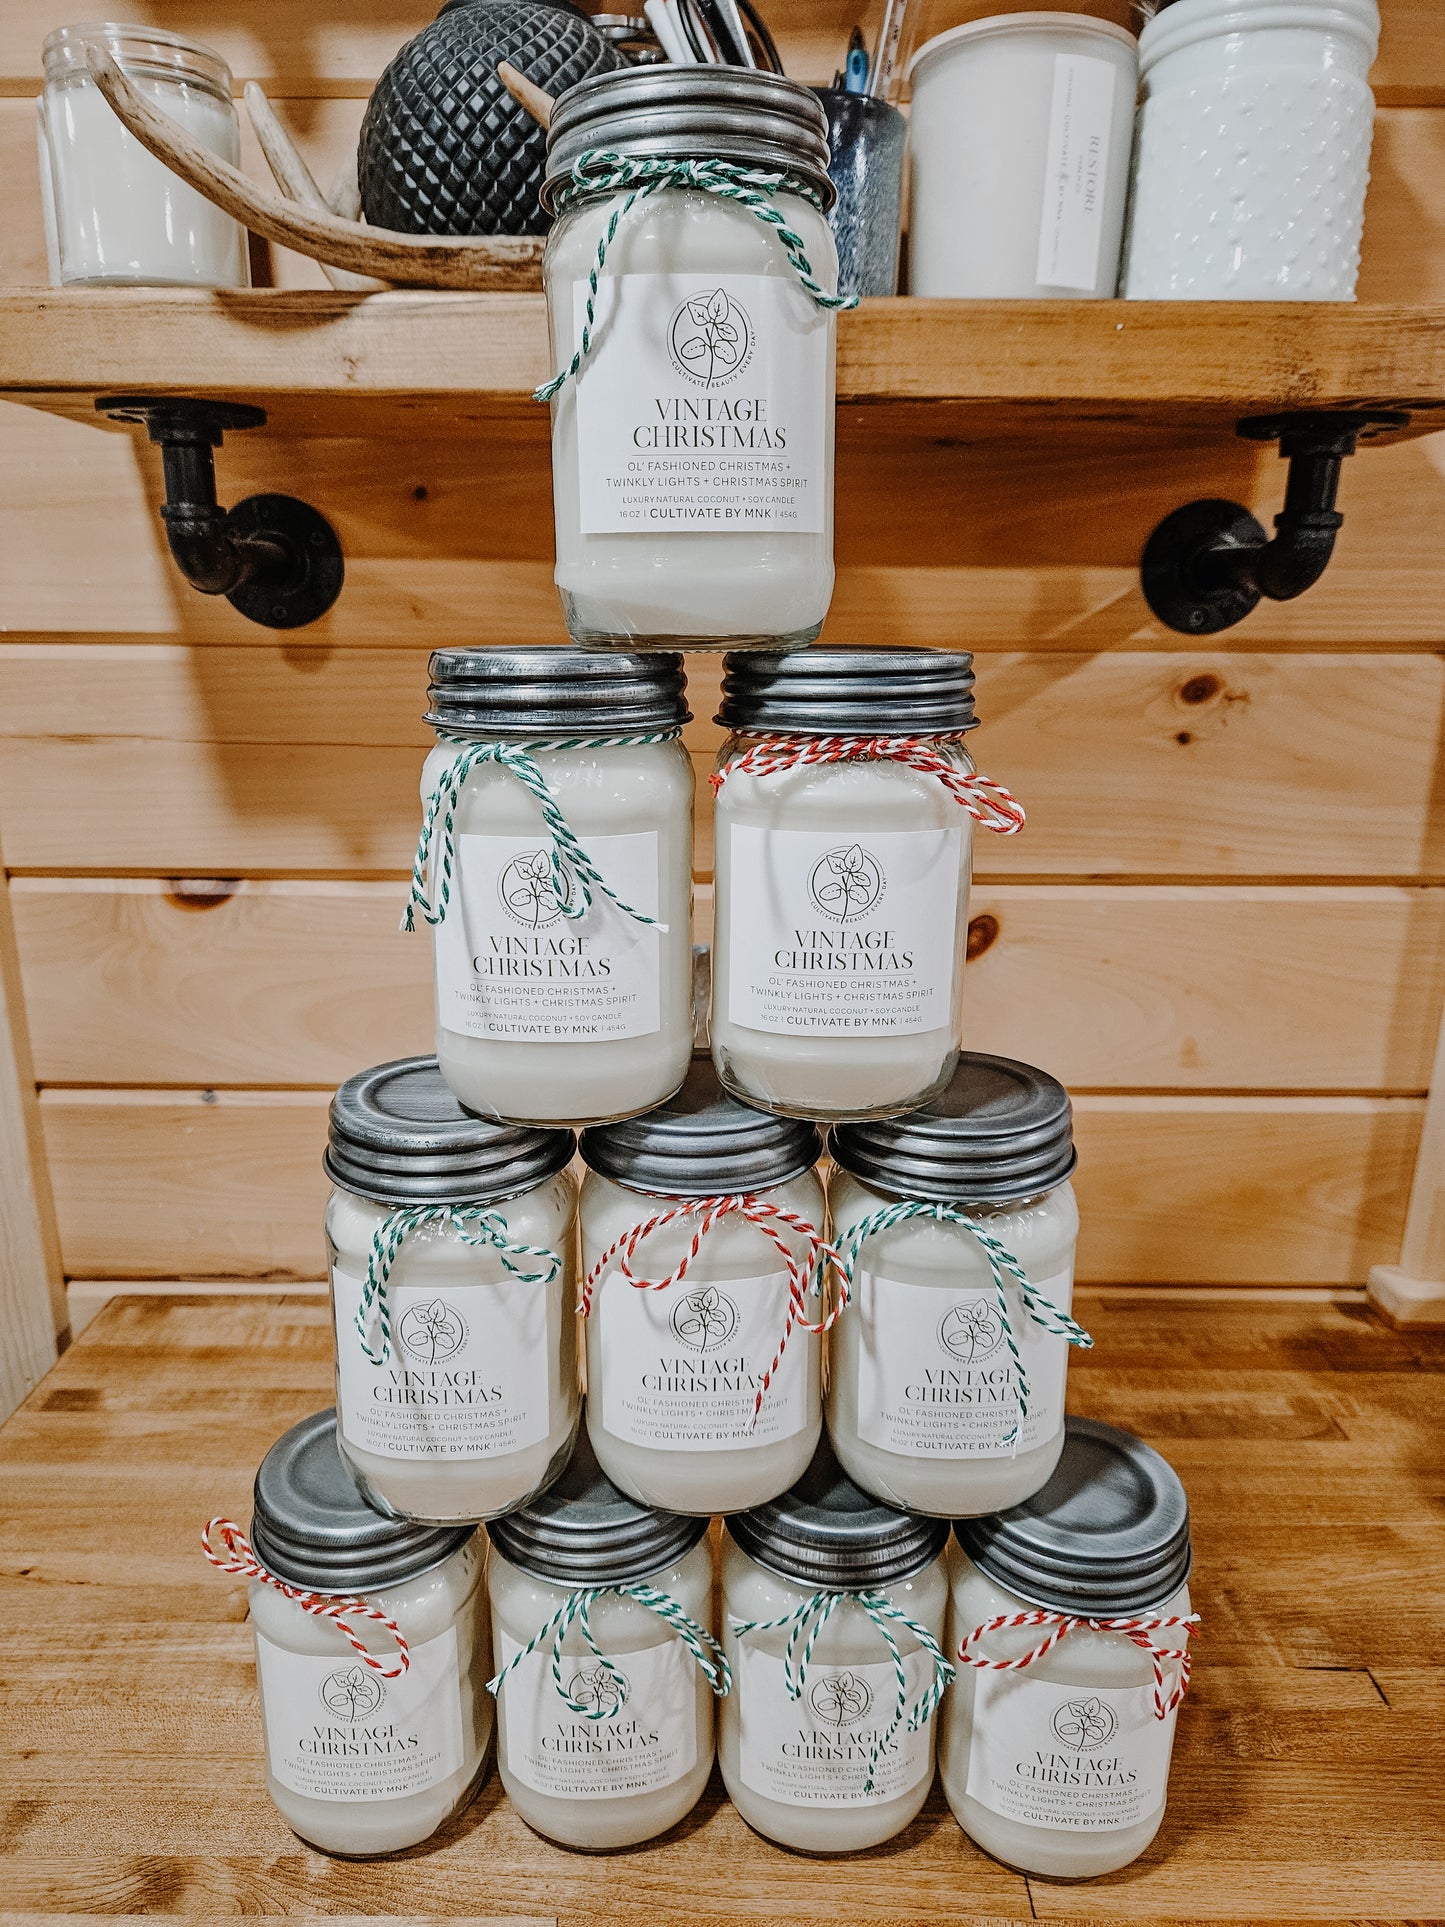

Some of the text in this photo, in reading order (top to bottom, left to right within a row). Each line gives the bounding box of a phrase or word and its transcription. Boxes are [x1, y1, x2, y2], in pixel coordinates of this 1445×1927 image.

[671, 360, 706, 388] CULTIVATE
[712, 375, 739, 388] BEAUTY
[740, 352, 754, 374] EVERY
[656, 398, 767, 422] VINTAGE
[633, 426, 786, 449] CHRISTMAS
[648, 462, 715, 471] FASHIONED
[720, 462, 783, 472] CHRISTMAS
[606, 478, 654, 487] TWINKLY
[658, 478, 700, 486] LIGHTS
[713, 478, 778, 487] CHRISTMAS
[780, 479, 808, 488] SPIRIT
[622, 496, 654, 504] LUXURY
[766, 496, 794, 504] CANDLE
[650, 508, 722, 518] CULTIVATE
[725, 508, 741, 518] BY
[745, 508, 771, 518] MNK
[810, 901, 840, 923] CULTIVATE
[845, 912, 870, 924] BEAUTY
[872, 892, 884, 911] EVERY
[502, 907, 533, 928] CULTIVATE
[537, 919, 561, 929] BEAUTY
[489, 936, 591, 956] VINTAGE
[795, 930, 895, 949] VINTAGE
[473, 957, 611, 977] CHRISTMAS
[775, 950, 913, 970] CHRISTMAS
[486, 986, 544, 995] FASHIONED
[547, 987, 608, 995] CHRISTMAS
[787, 980, 847, 989] FASHIONED
[850, 980, 909, 989] CHRISTMAS
[455, 991, 492, 1004] TWINKLY
[494, 997, 530, 1006] LIGHTS
[543, 997, 603, 1006] CHRISTMAS
[607, 994, 637, 1004] SPIRIT
[751, 986, 791, 999] TWINKLY
[795, 991, 833, 1000] LIGHTS
[844, 991, 903, 1001] CHRISTMAS
[906, 988, 934, 999] SPIRIT
[467, 1011, 492, 1019] LUXURY
[764, 1004, 792, 1012] LUXURY
[891, 1005, 920, 1013] CANDLE
[489, 1023, 550, 1033] CULTIVATE
[555, 1025, 568, 1033] BY
[573, 1024, 597, 1033] MNK
[787, 1016, 850, 1026] CULTIVATE
[854, 1017, 868, 1026] BY
[872, 1017, 897, 1026] MNK
[660, 1357, 751, 1375] VINTAGE
[389, 1369, 484, 1386] VINTAGE
[373, 1385, 503, 1405] CHRISTMAS
[622, 1398, 788, 1417] TWINKLY LIGHTS SPIRIT
[653, 1399, 708, 1408] FASHIONED
[356, 1412, 527, 1431] TWINKLY LIGHTS CHRISTMAS SPIRIT
[385, 1410, 440, 1421] FASHIONED
[444, 1409, 501, 1421] CHRISTMAS
[881, 1412, 920, 1427] TWINKLY
[924, 1420, 959, 1429] LIGHTS
[916, 1410, 972, 1419] FASHIONED
[655, 1430, 713, 1440] CULTIVATE
[716, 1431, 730, 1440] BY
[389, 1442, 491, 1453] CULTIVATE BY MNK
[916, 1440, 990, 1450] CULTIVATE BY
[314, 1723, 400, 1740] VINTAGE
[557, 1720, 641, 1738] VINTAGE
[299, 1734, 418, 1755] CHRISTMAS
[542, 1731, 659, 1753] CHRISTMAS
[284, 1752, 442, 1777] TWINKLY LIGHTS CHRISTMAS SPIRIT
[310, 1760, 362, 1769] FASHIONED
[364, 1754, 418, 1768] CHRISTMAS
[552, 1758, 604, 1767] FASHIONED
[605, 1751, 657, 1765] CHRISTMAS
[1036, 1751, 1124, 1771] VINTAGE
[792, 1764, 844, 1773] FASHIONED
[1016, 1762, 1137, 1785] CHRISTMAS
[314, 1784, 409, 1795] CULTIVATE BY MNK
[554, 1781, 648, 1793] CULTIVATE BY MNK
[793, 1790, 847, 1799] CULTIVATE
[851, 1791, 863, 1799] BY
[990, 1780, 1151, 1808] TWINKLY LIGHTS CHRISTMAS SPIRIT
[1025, 1785, 1079, 1798] FASHIONED
[1082, 1789, 1133, 1799] CHRISTMAS
[1023, 1811, 1120, 1826] CULTIVATE BY MNK
